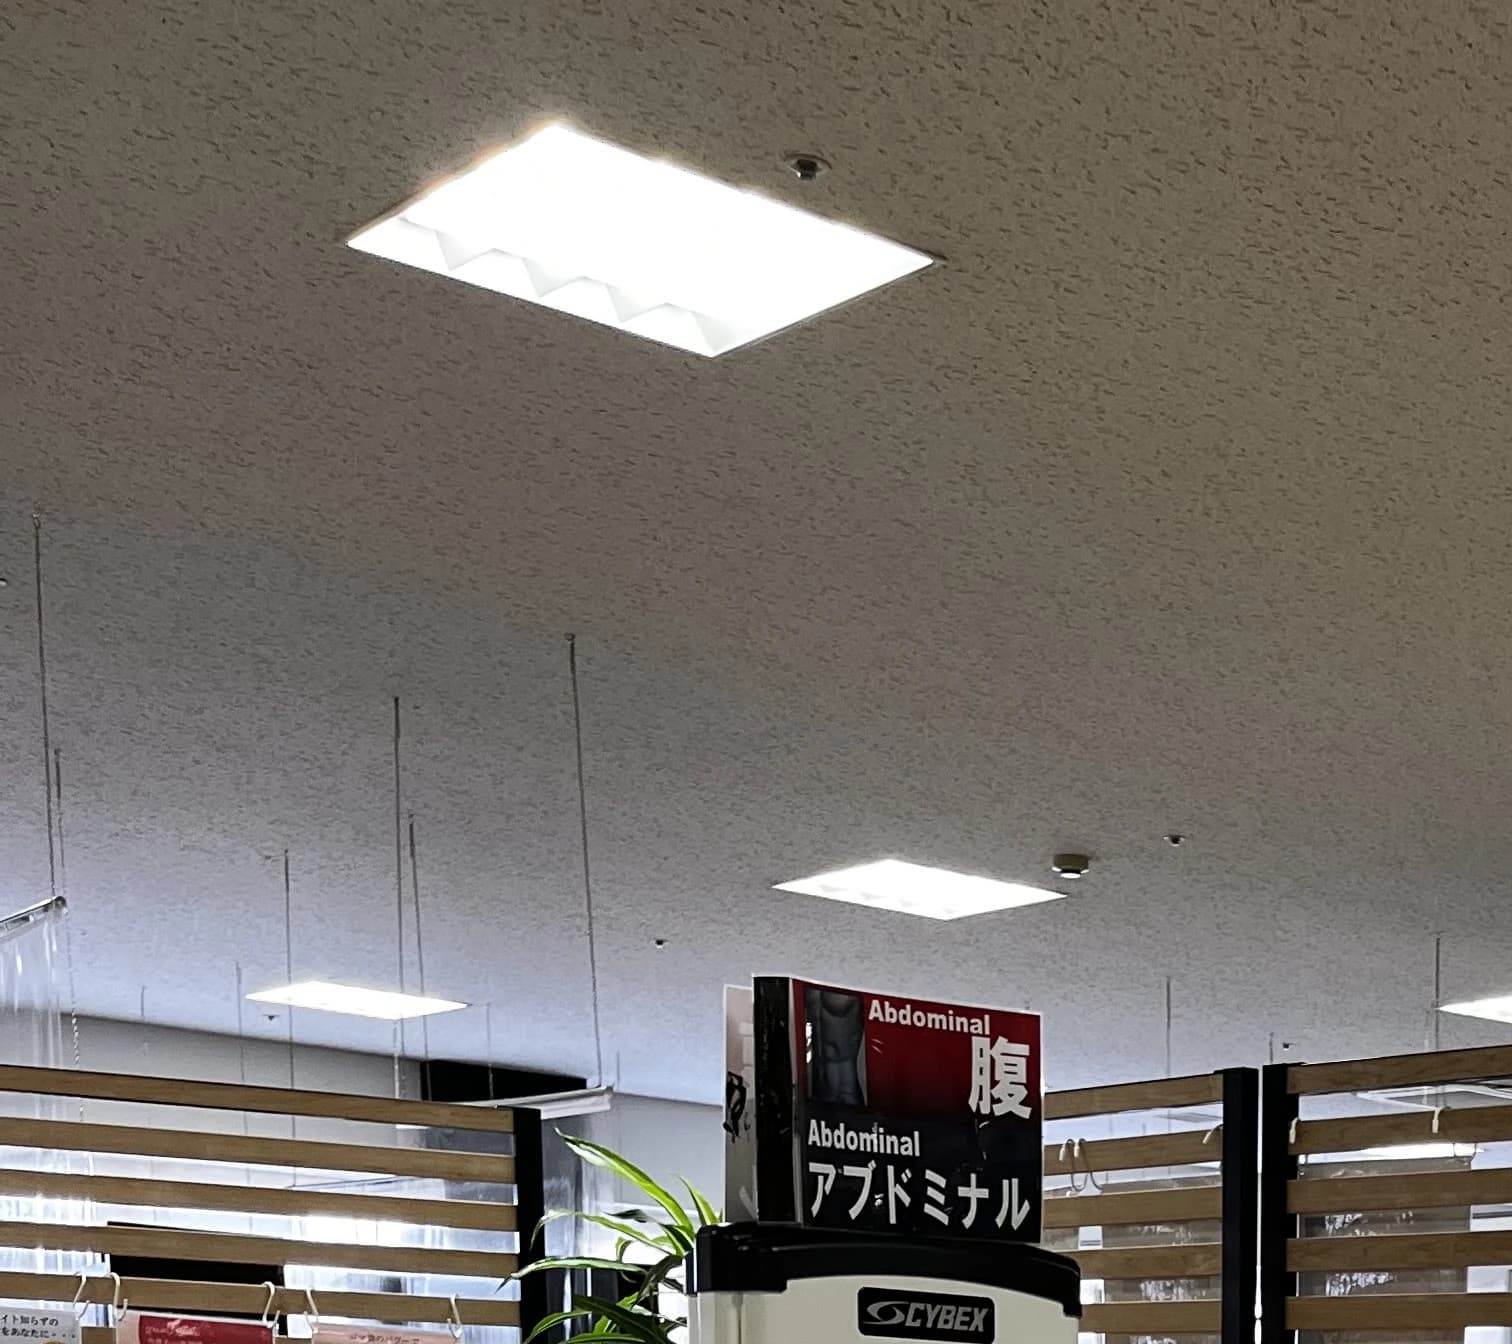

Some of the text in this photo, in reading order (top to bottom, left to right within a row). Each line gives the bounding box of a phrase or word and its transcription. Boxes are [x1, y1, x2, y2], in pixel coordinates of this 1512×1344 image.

[868, 999, 990, 1035] Abdominal
[968, 1036, 1032, 1119] 腹
[808, 1119, 920, 1157] Abdominal
[808, 1160, 1031, 1231] アブドミナル
[904, 1303, 990, 1333] CYBEX
